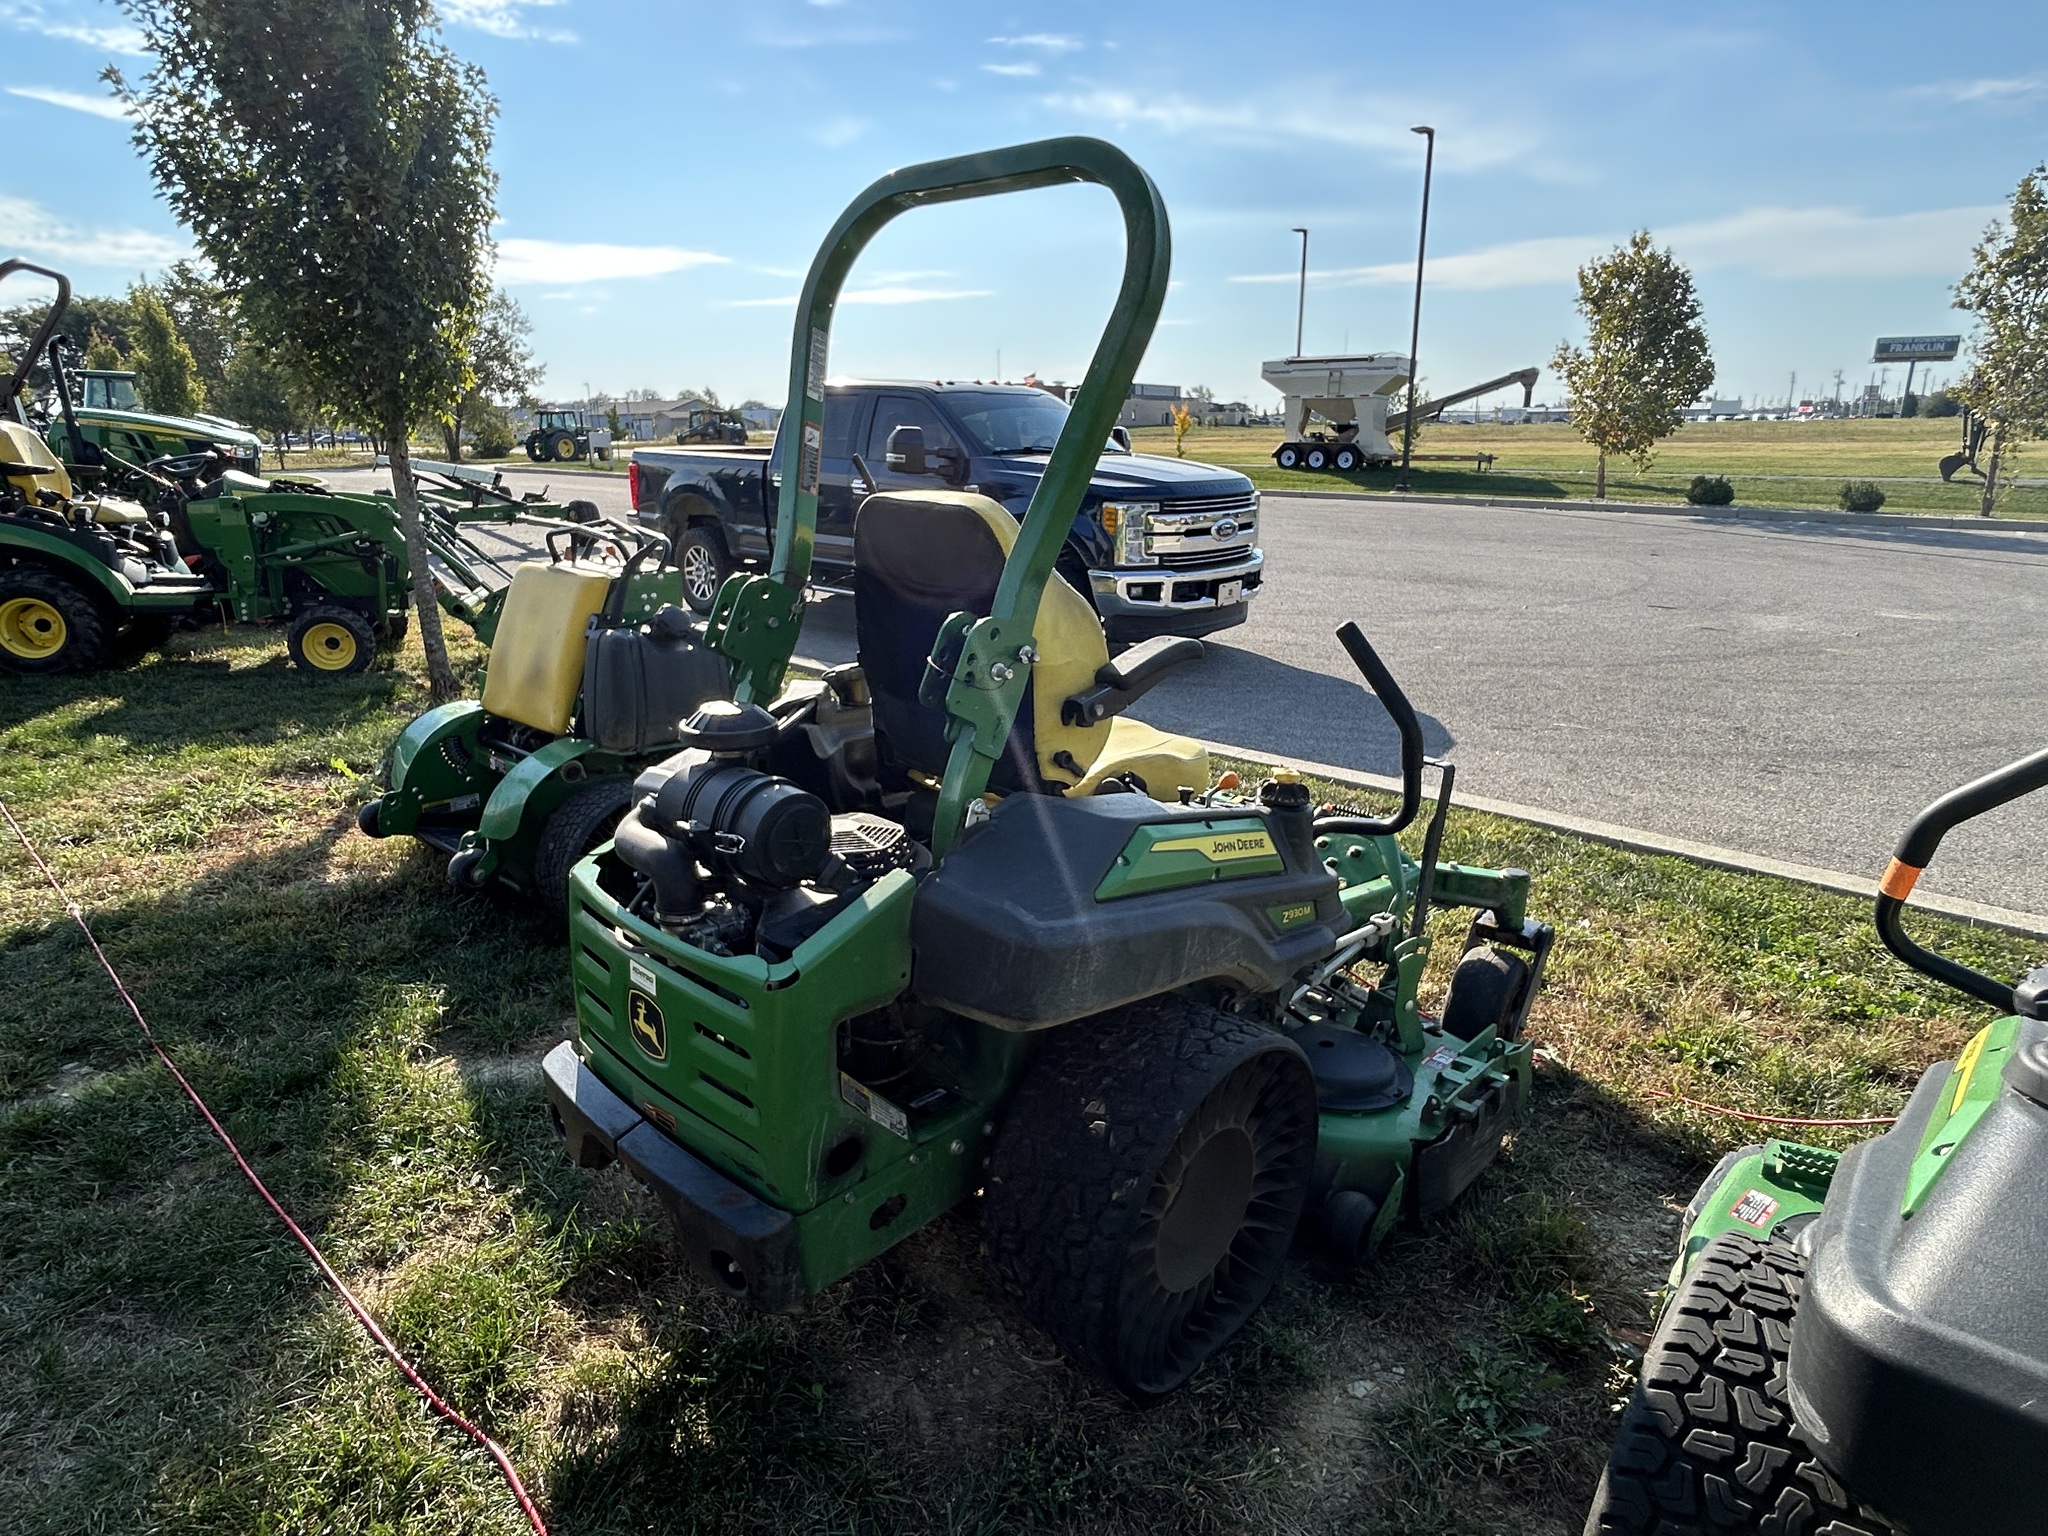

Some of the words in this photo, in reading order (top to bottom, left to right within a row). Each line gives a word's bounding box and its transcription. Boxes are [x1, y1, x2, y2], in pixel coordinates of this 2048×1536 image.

[1889, 343, 1945, 353] FRANKLIN
[1212, 840, 1237, 854] JOHN
[1237, 838, 1265, 851] DEERE
[1282, 905, 1311, 923] Z930M
